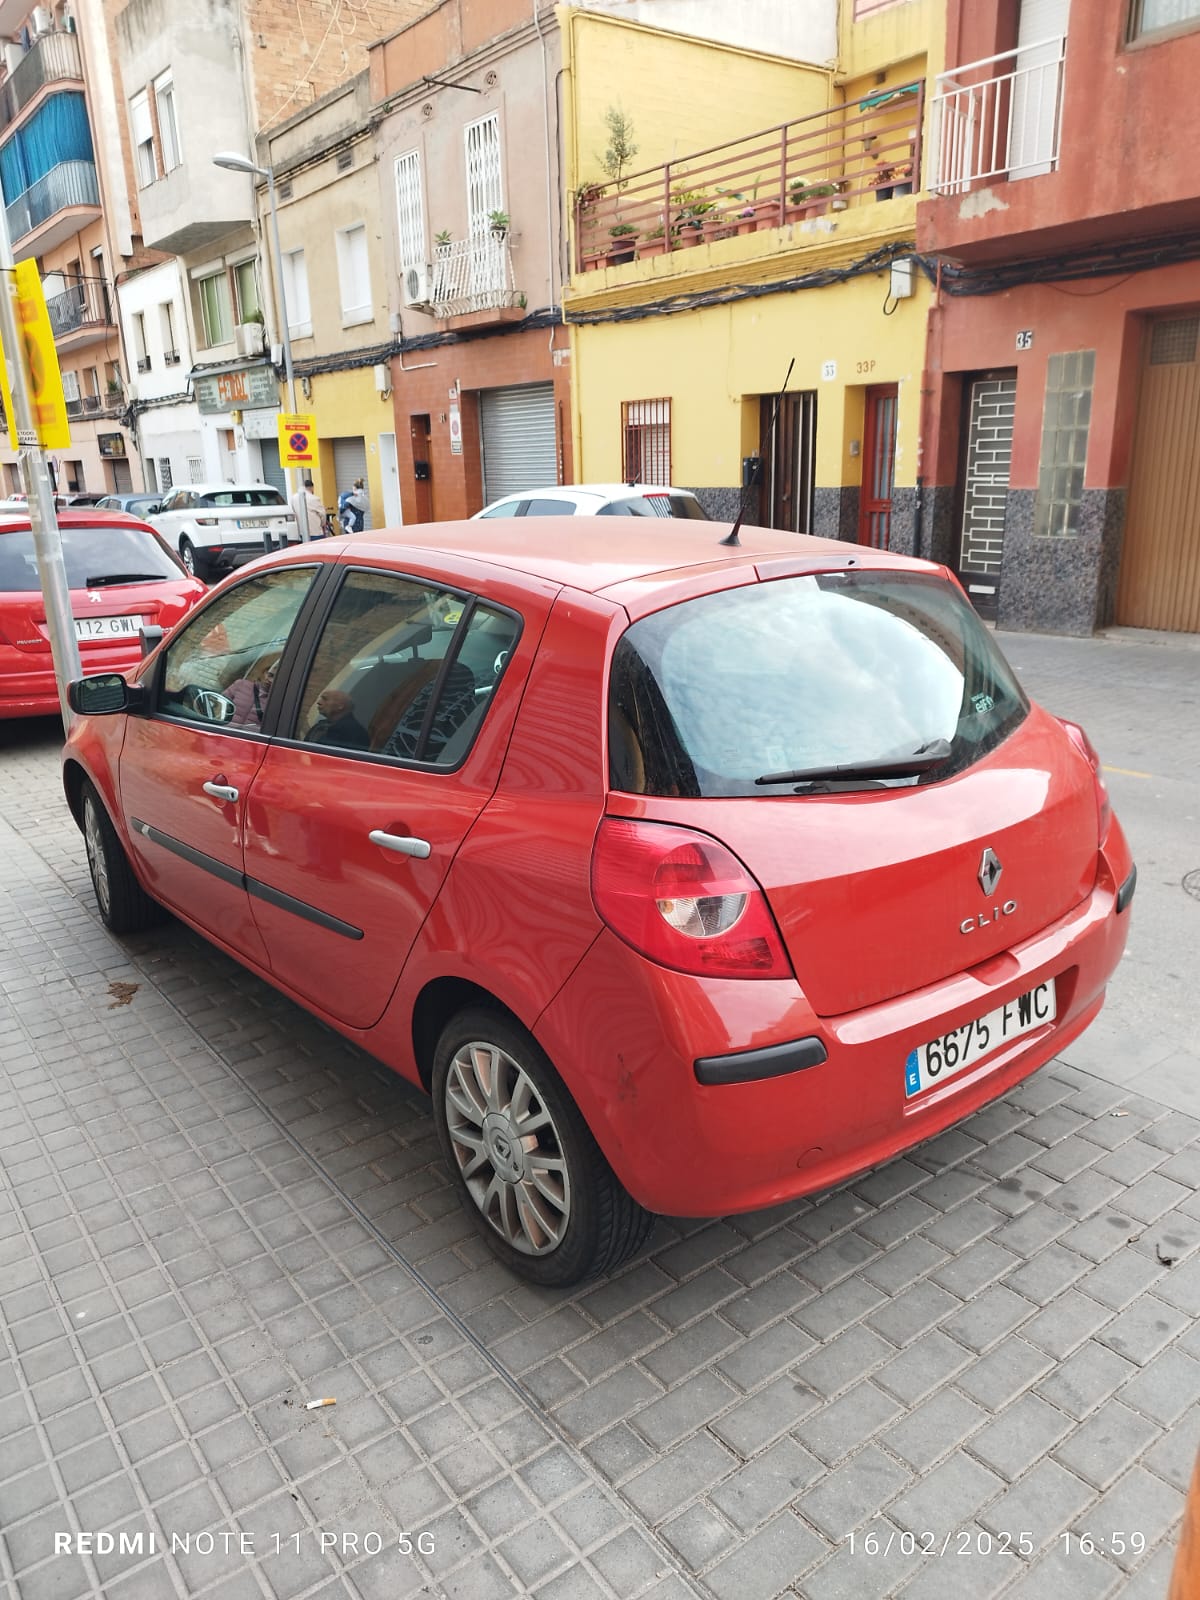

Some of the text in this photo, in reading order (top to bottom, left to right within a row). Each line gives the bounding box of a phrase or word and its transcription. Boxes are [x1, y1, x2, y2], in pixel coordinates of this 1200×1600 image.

[1016, 331, 1032, 349] 35
[856, 359, 876, 374] 33P
[110, 618, 140, 633] GWL
[959, 900, 1017, 934] CLIO
[926, 983, 1049, 1077] 6675 FWC
[909, 1073, 917, 1085] E
